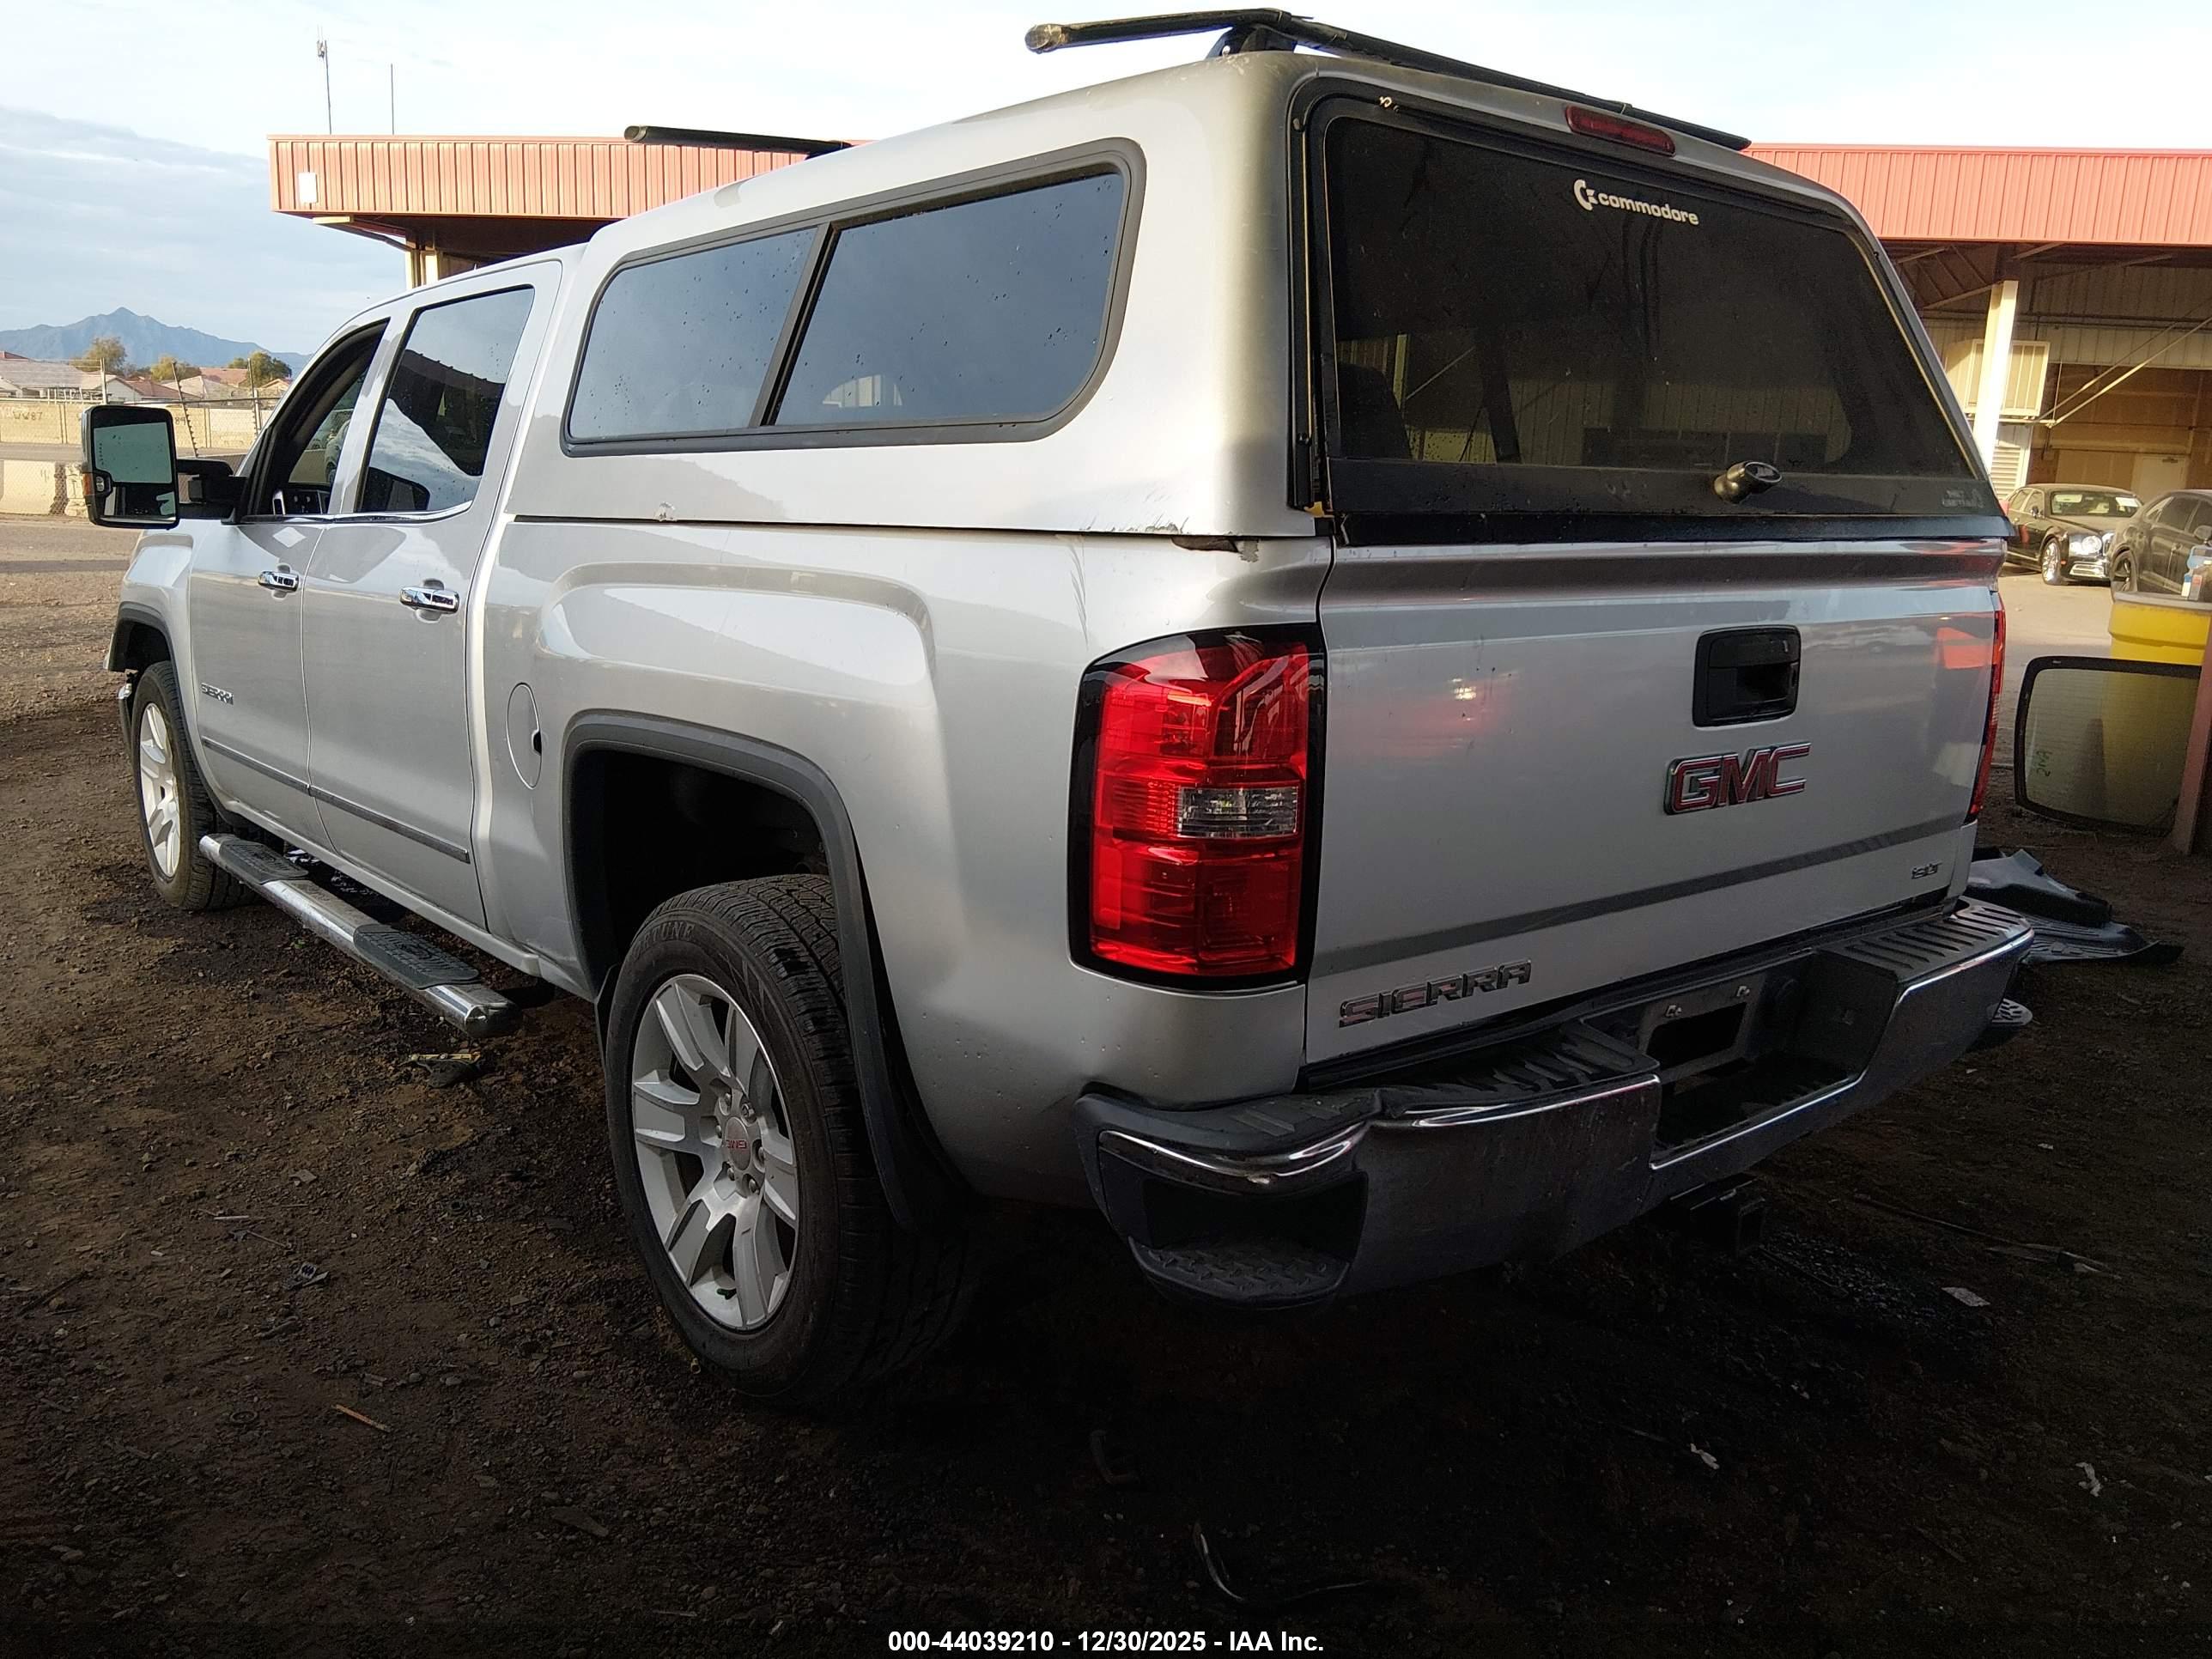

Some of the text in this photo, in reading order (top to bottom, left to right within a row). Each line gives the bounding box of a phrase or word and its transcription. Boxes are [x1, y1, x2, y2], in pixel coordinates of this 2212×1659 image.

[1597, 191, 1700, 227] commodore
[1664, 740, 1812, 815] GMC
[1339, 957, 1533, 1029] SIERRA
